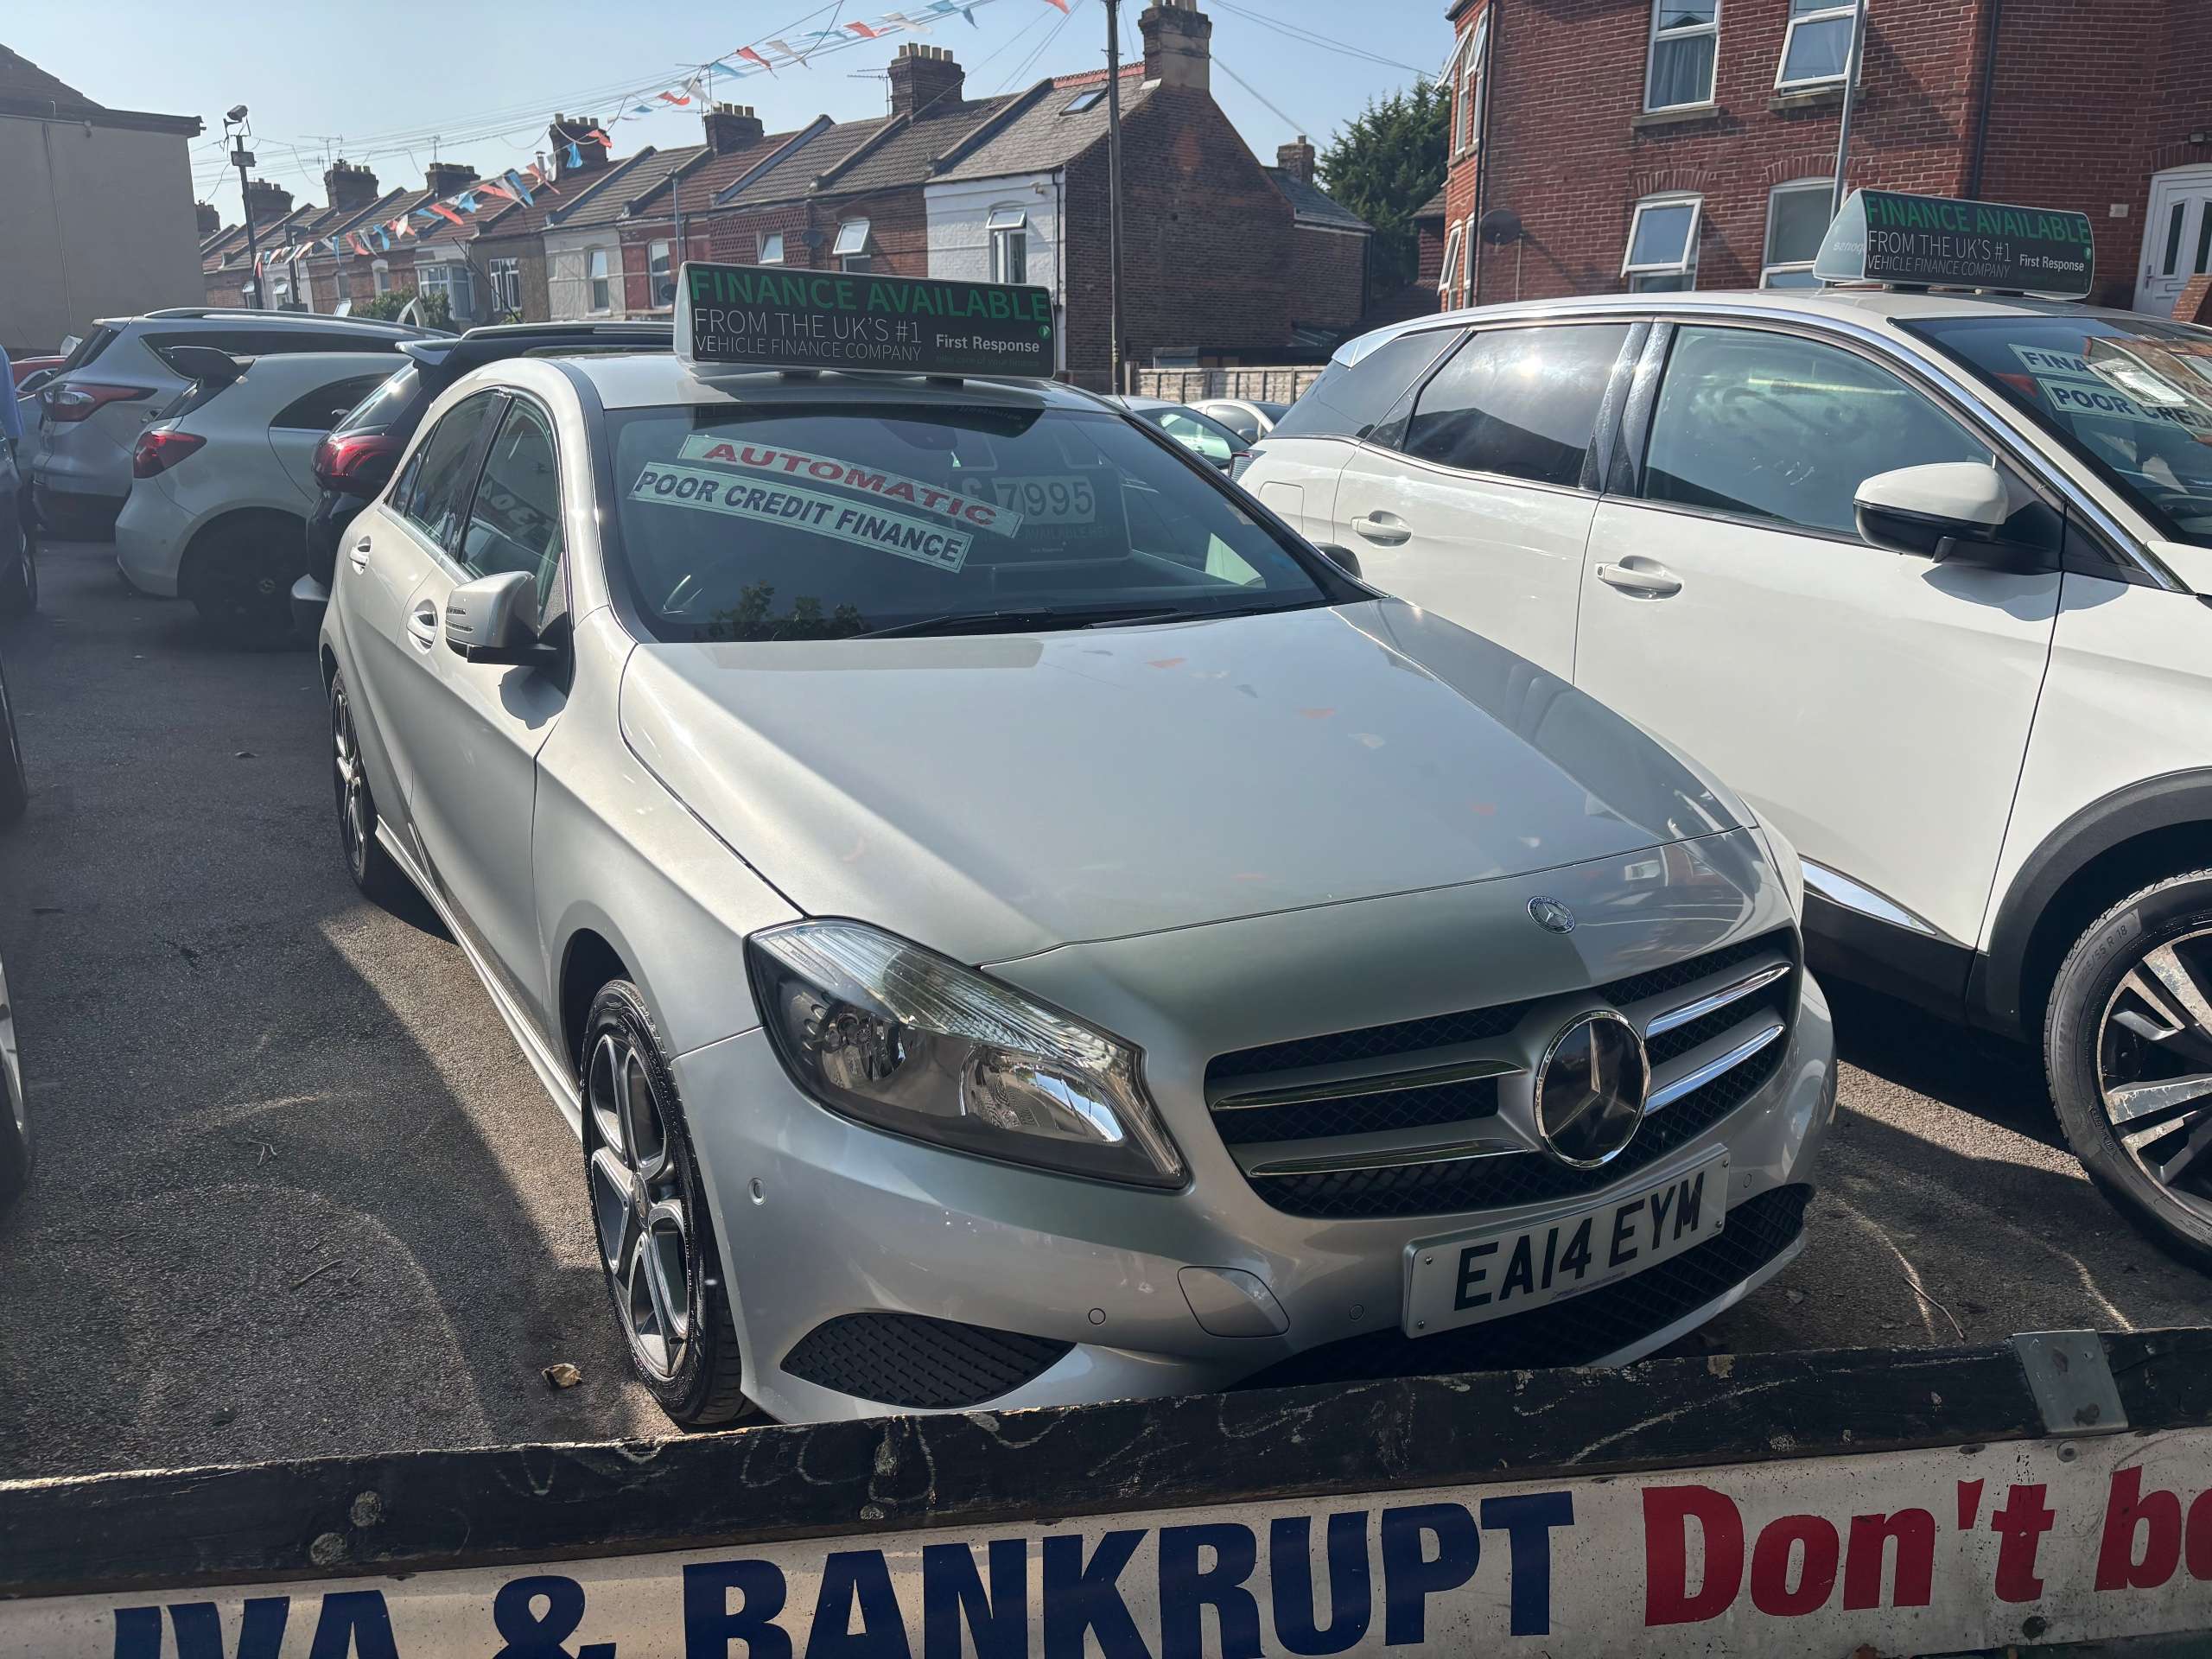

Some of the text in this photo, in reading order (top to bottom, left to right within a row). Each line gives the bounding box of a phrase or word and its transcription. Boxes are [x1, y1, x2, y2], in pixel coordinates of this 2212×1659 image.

[1864, 195, 2092, 244] FINANCE AVAILABLE
[1867, 230, 2012, 263] FROM THE UK'S #1
[2019, 253, 2085, 273] First Response
[1867, 254, 2012, 279] VEHICLE FINANCE COMPANY
[691, 269, 1051, 323] FINANCE AVAILABLE
[695, 308, 922, 344] FROM THE UK'S #1
[936, 334, 1040, 354] First Response
[695, 334, 922, 362] VEHICLE FINANCE COMPANY
[2021, 351, 2088, 372] FINA
[2050, 385, 2212, 429] POOR CRED
[702, 443, 997, 526] AUTOMATIC
[995, 481, 1094, 517] 7995
[634, 471, 720, 503] POOR
[724, 485, 834, 525] CREDIT
[834, 508, 963, 563] FINANCE
[2115, 925, 2127, 940] 18
[1453, 1171, 1705, 1312] EA14 EYM
[682, 1490, 1575, 1659] BANKRUPT
[1642, 1477, 2056, 1627] Don't
